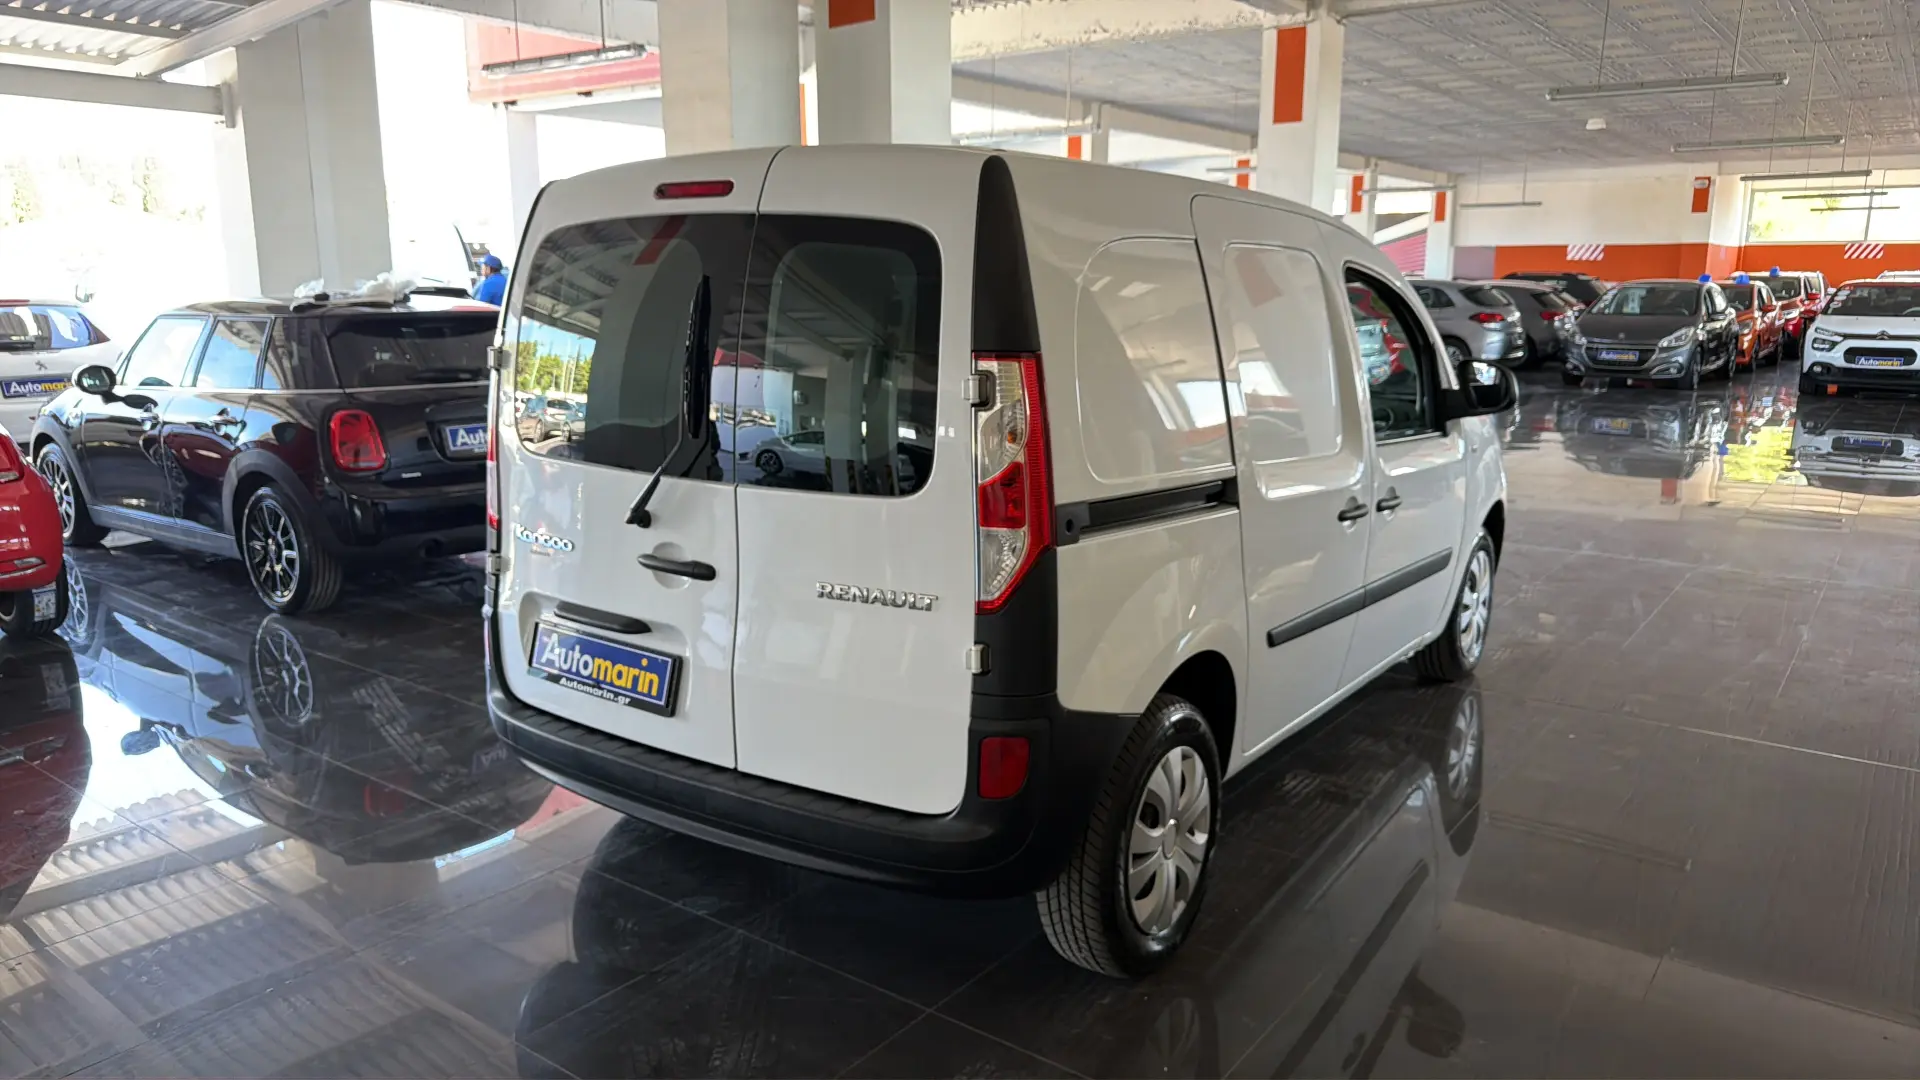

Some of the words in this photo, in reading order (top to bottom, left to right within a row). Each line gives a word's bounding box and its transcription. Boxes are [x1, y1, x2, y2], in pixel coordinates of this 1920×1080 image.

[816, 580, 938, 612] RENAULT
[541, 633, 659, 696] Automarin
[560, 677, 631, 706] Automarin.gr
